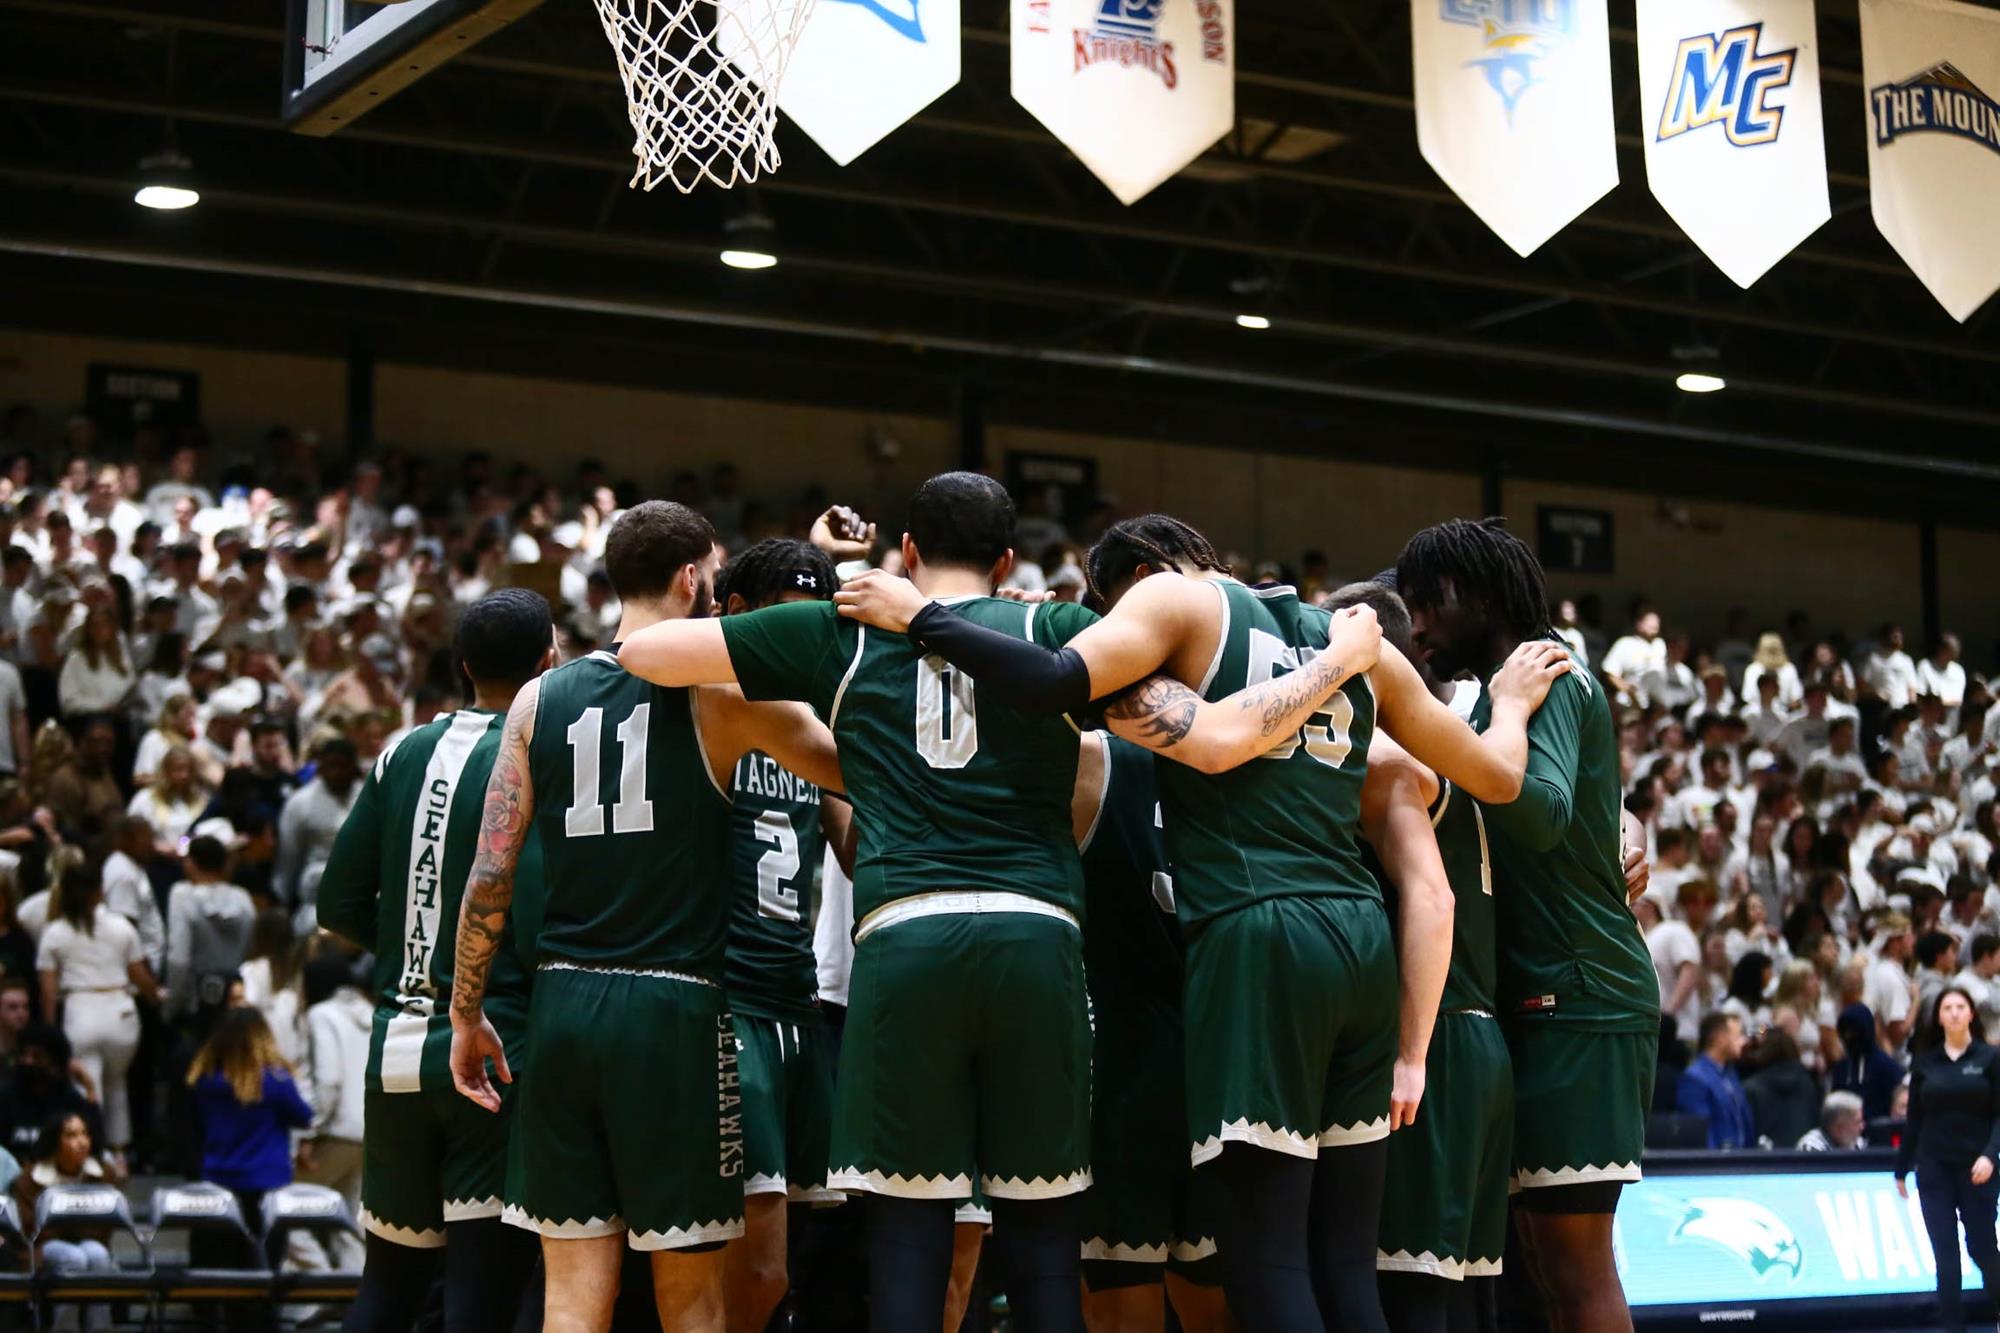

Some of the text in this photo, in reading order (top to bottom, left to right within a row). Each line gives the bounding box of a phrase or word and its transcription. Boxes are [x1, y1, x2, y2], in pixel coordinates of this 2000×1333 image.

[1656, 22, 1797, 147] MC
[1873, 87, 1927, 139] THE
[916, 653, 978, 769] 0
[565, 702, 654, 837] 11
[753, 809, 801, 922] 2
